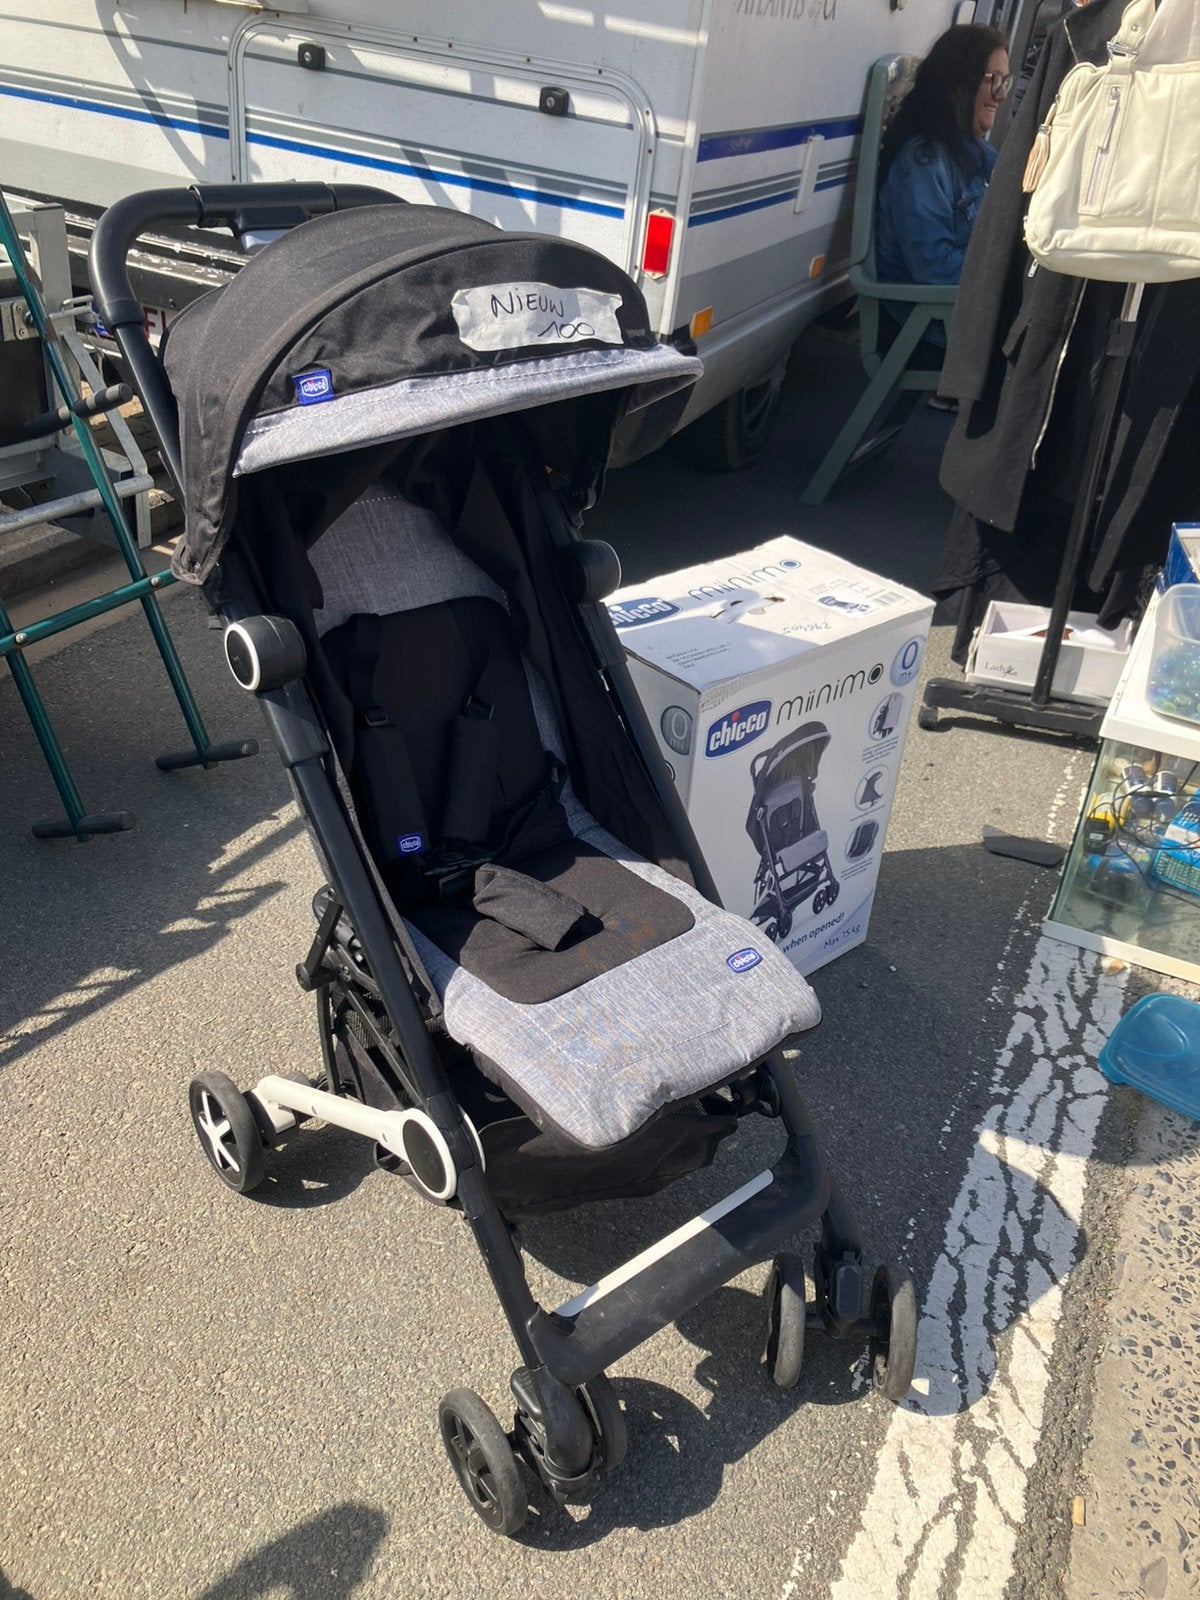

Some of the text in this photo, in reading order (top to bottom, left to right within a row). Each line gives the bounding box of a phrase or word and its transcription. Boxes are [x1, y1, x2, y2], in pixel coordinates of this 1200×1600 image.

[538, 321, 596, 339] 100
[609, 599, 674, 626] hicco
[687, 559, 802, 601] miinimo
[902, 641, 919, 670] 0
[709, 709, 768, 752] chicco
[776, 662, 885, 726] miinimo
[782, 911, 846, 954] when opened!
[823, 935, 840, 950] Max
